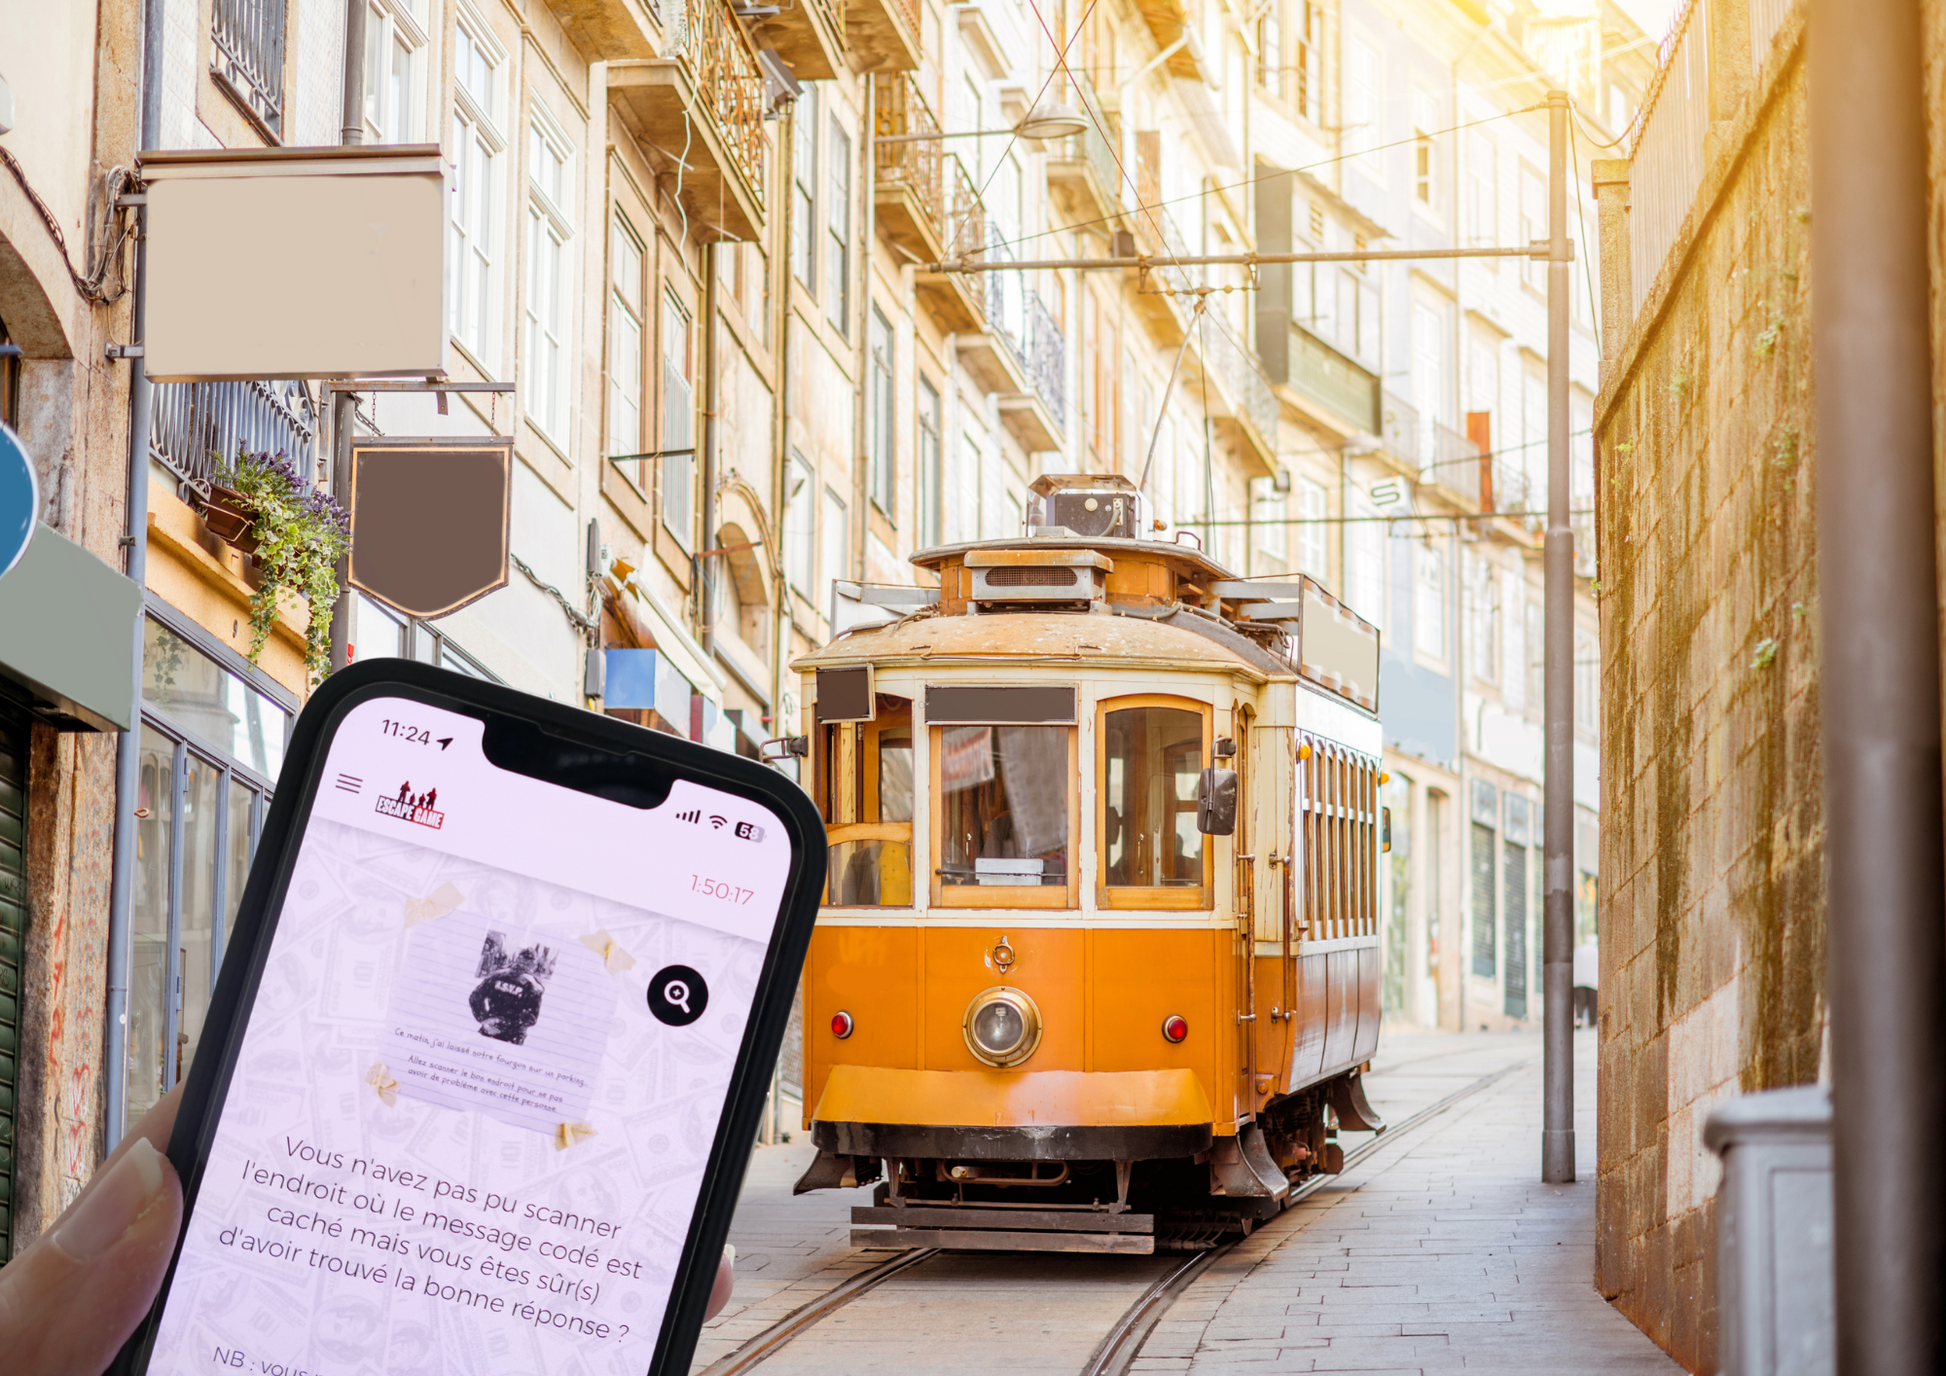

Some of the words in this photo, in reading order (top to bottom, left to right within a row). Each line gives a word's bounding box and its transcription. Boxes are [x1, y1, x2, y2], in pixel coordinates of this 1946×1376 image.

[382, 719, 431, 746] 11:24
[376, 795, 416, 821] ESCAPE
[412, 805, 443, 829] GAME
[738, 823, 760, 841] 58
[692, 874, 754, 905] 1:50:17
[395, 1028, 405, 1037] Ce
[430, 1038, 445, 1049] j'ai
[446, 1041, 471, 1054] laissé
[472, 1050, 494, 1061] notre
[496, 1054, 527, 1070] fourgon
[545, 1069, 555, 1078] un
[408, 1055, 427, 1066] Allez
[429, 1062, 459, 1075] scanner
[460, 1068, 468, 1077] le
[470, 1071, 485, 1082] bon
[487, 1077, 516, 1090] endroit
[516, 1085, 537, 1095] pour
[538, 1091, 547, 1099] ne
[549, 1094, 563, 1103] pas
[408, 1068, 428, 1078] avoir
[430, 1072, 440, 1082] de
[441, 1077, 479, 1092] problème
[480, 1088, 498, 1097] avec
[499, 1092, 520, 1102] cette
[286, 1136, 344, 1169] Vous
[351, 1158, 428, 1191] n'avez
[433, 1179, 478, 1204] pas
[483, 1193, 518, 1214] pu
[523, 1203, 622, 1239] scanner
[242, 1159, 347, 1205] l'endroit
[353, 1193, 386, 1215] où
[393, 1198, 415, 1222] le
[422, 1210, 532, 1252] message
[538, 1245, 600, 1268] codé
[606, 1258, 643, 1280] est
[267, 1207, 343, 1238] caché
[350, 1227, 411, 1256] mais
[418, 1244, 472, 1271] vous
[480, 1255, 531, 1285] êtes
[536, 1272, 600, 1305] sûr(s)
[219, 1226, 303, 1262] d'avoir
[309, 1248, 388, 1284] trouvé
[394, 1267, 416, 1291] la
[423, 1275, 505, 1313] bonne
[511, 1301, 610, 1338] réponse
[618, 1324, 630, 1343] ?
[213, 1346, 246, 1368] NB
